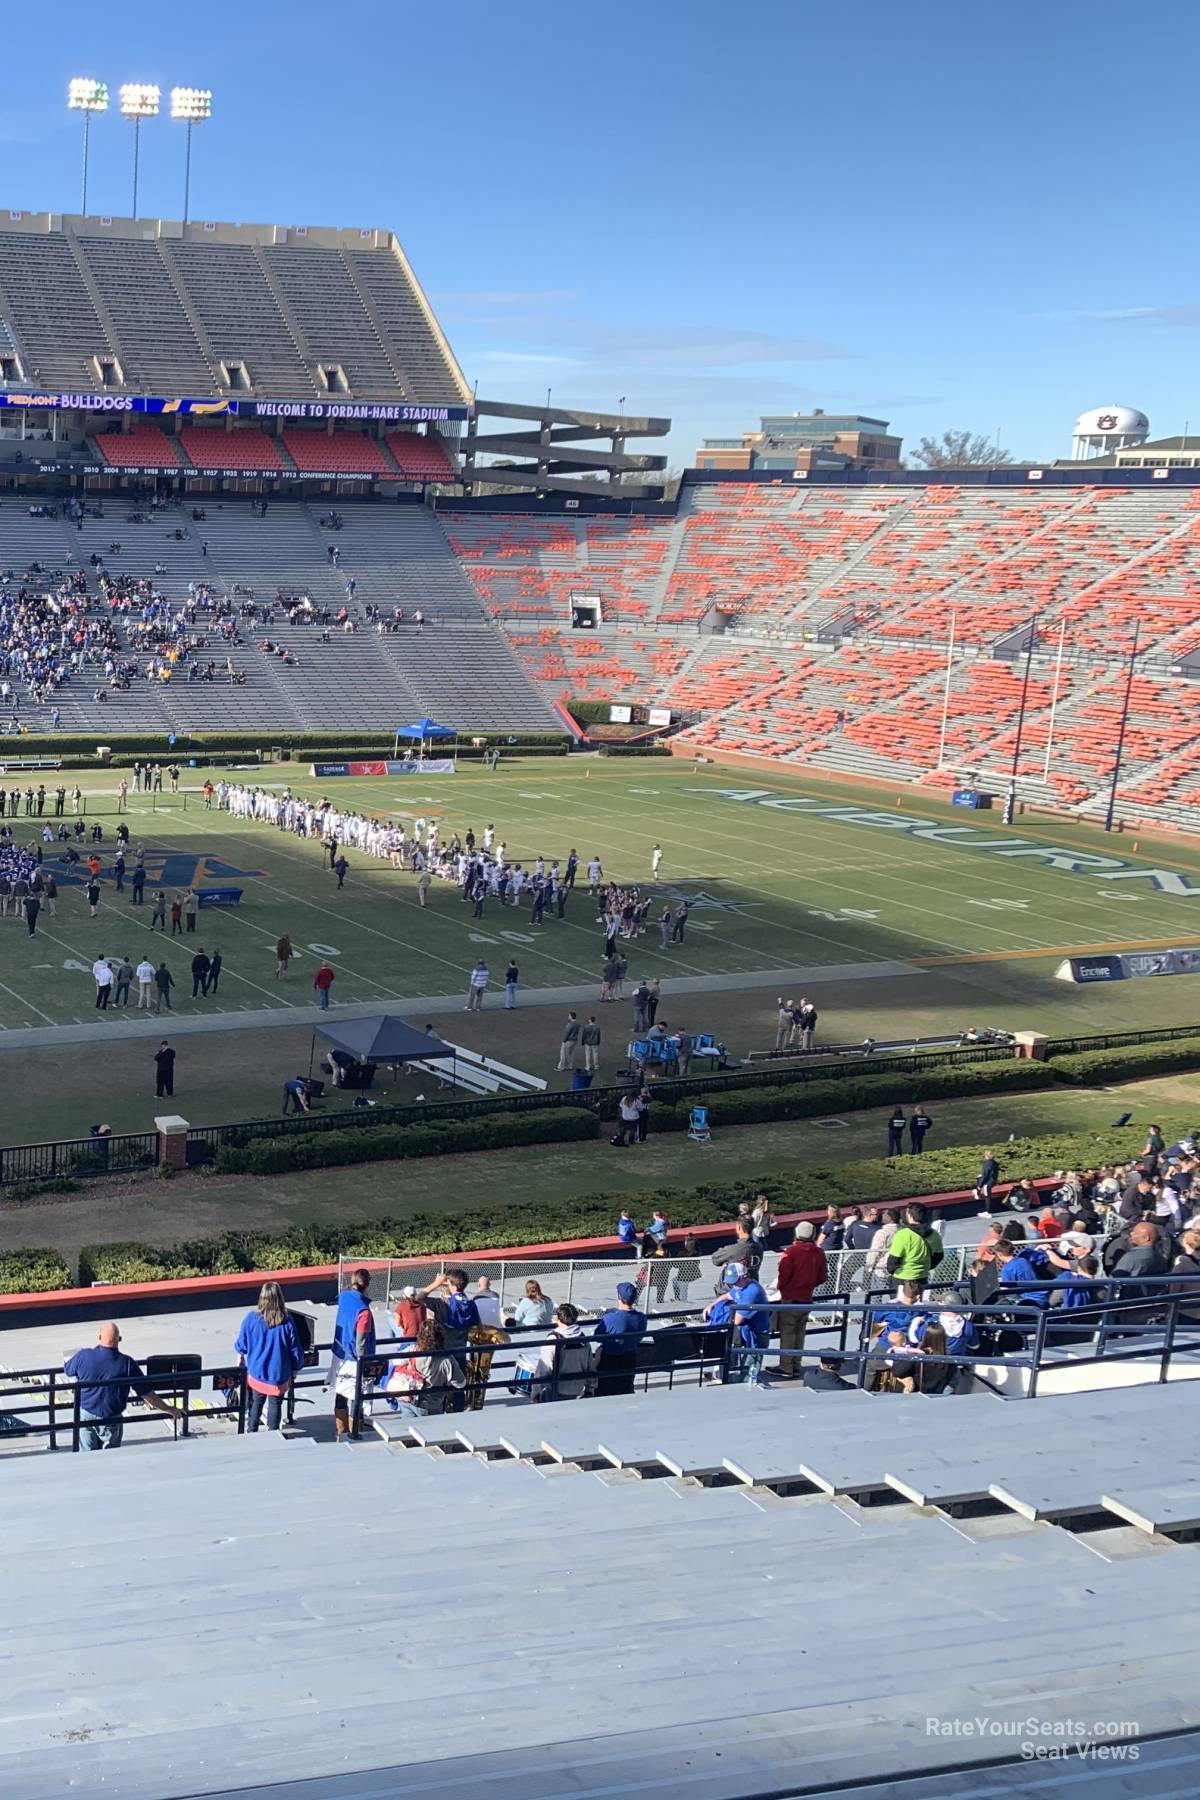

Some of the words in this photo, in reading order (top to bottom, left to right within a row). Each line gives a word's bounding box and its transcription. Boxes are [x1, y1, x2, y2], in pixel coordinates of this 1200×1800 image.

[7, 395, 58, 406] PIEDMONT
[61, 395, 133, 410] BULLDOGS
[256, 403, 306, 416] WELCOME
[310, 404, 323, 417] TO
[326, 405, 399, 419] JORDAN-HARE
[402, 407, 448, 420] STADIUM
[469, 930, 535, 945] 40
